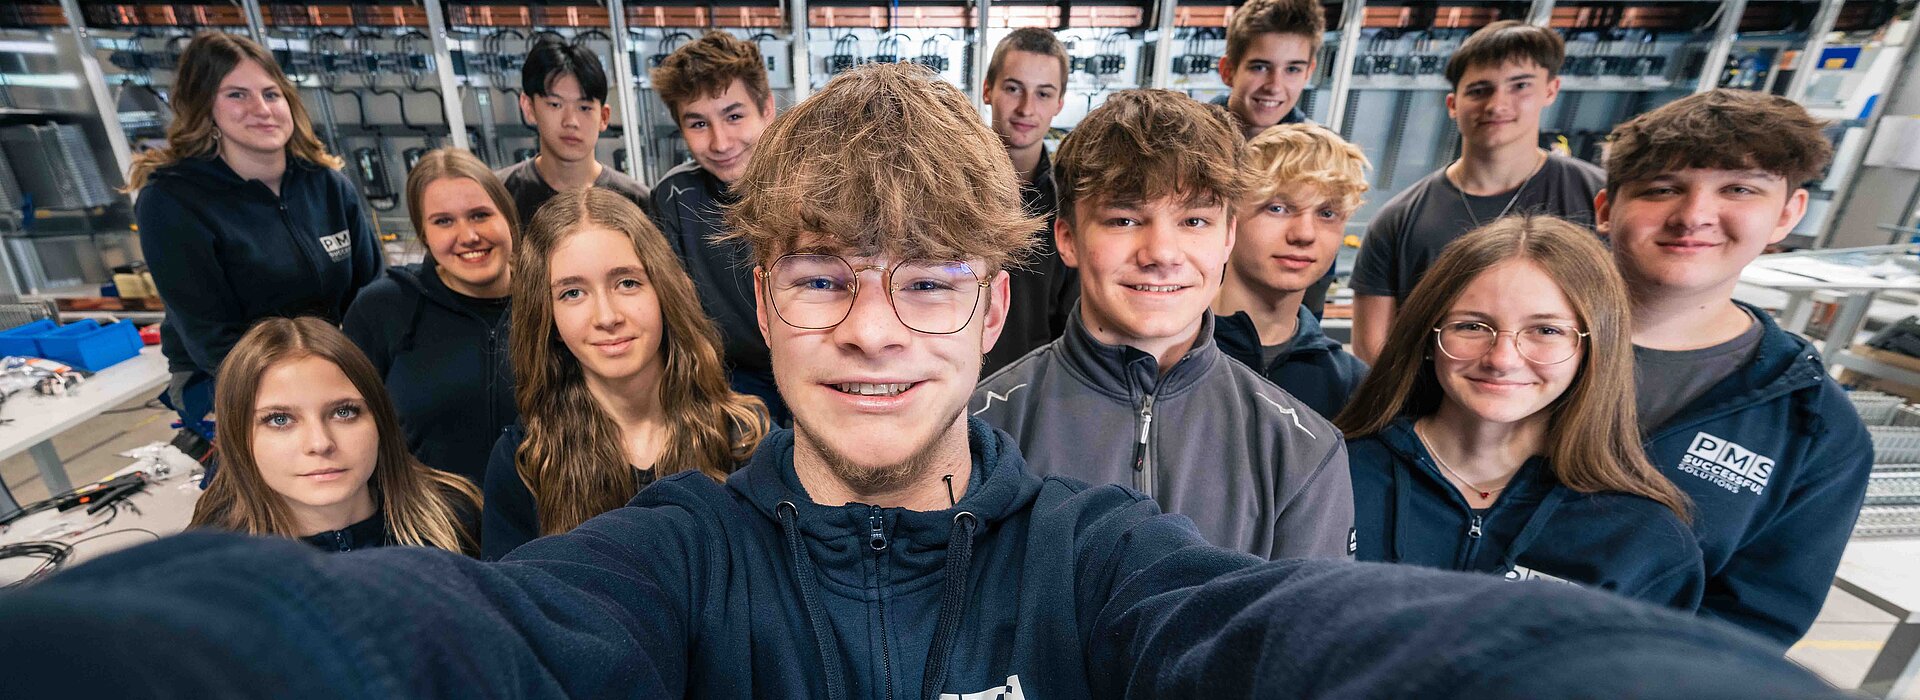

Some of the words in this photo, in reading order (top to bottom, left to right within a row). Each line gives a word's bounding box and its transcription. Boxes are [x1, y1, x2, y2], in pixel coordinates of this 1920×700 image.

[322, 232, 350, 250] PM
[1693, 436, 1773, 481] PMS
[1677, 463, 1739, 494] SOLUTIONS
